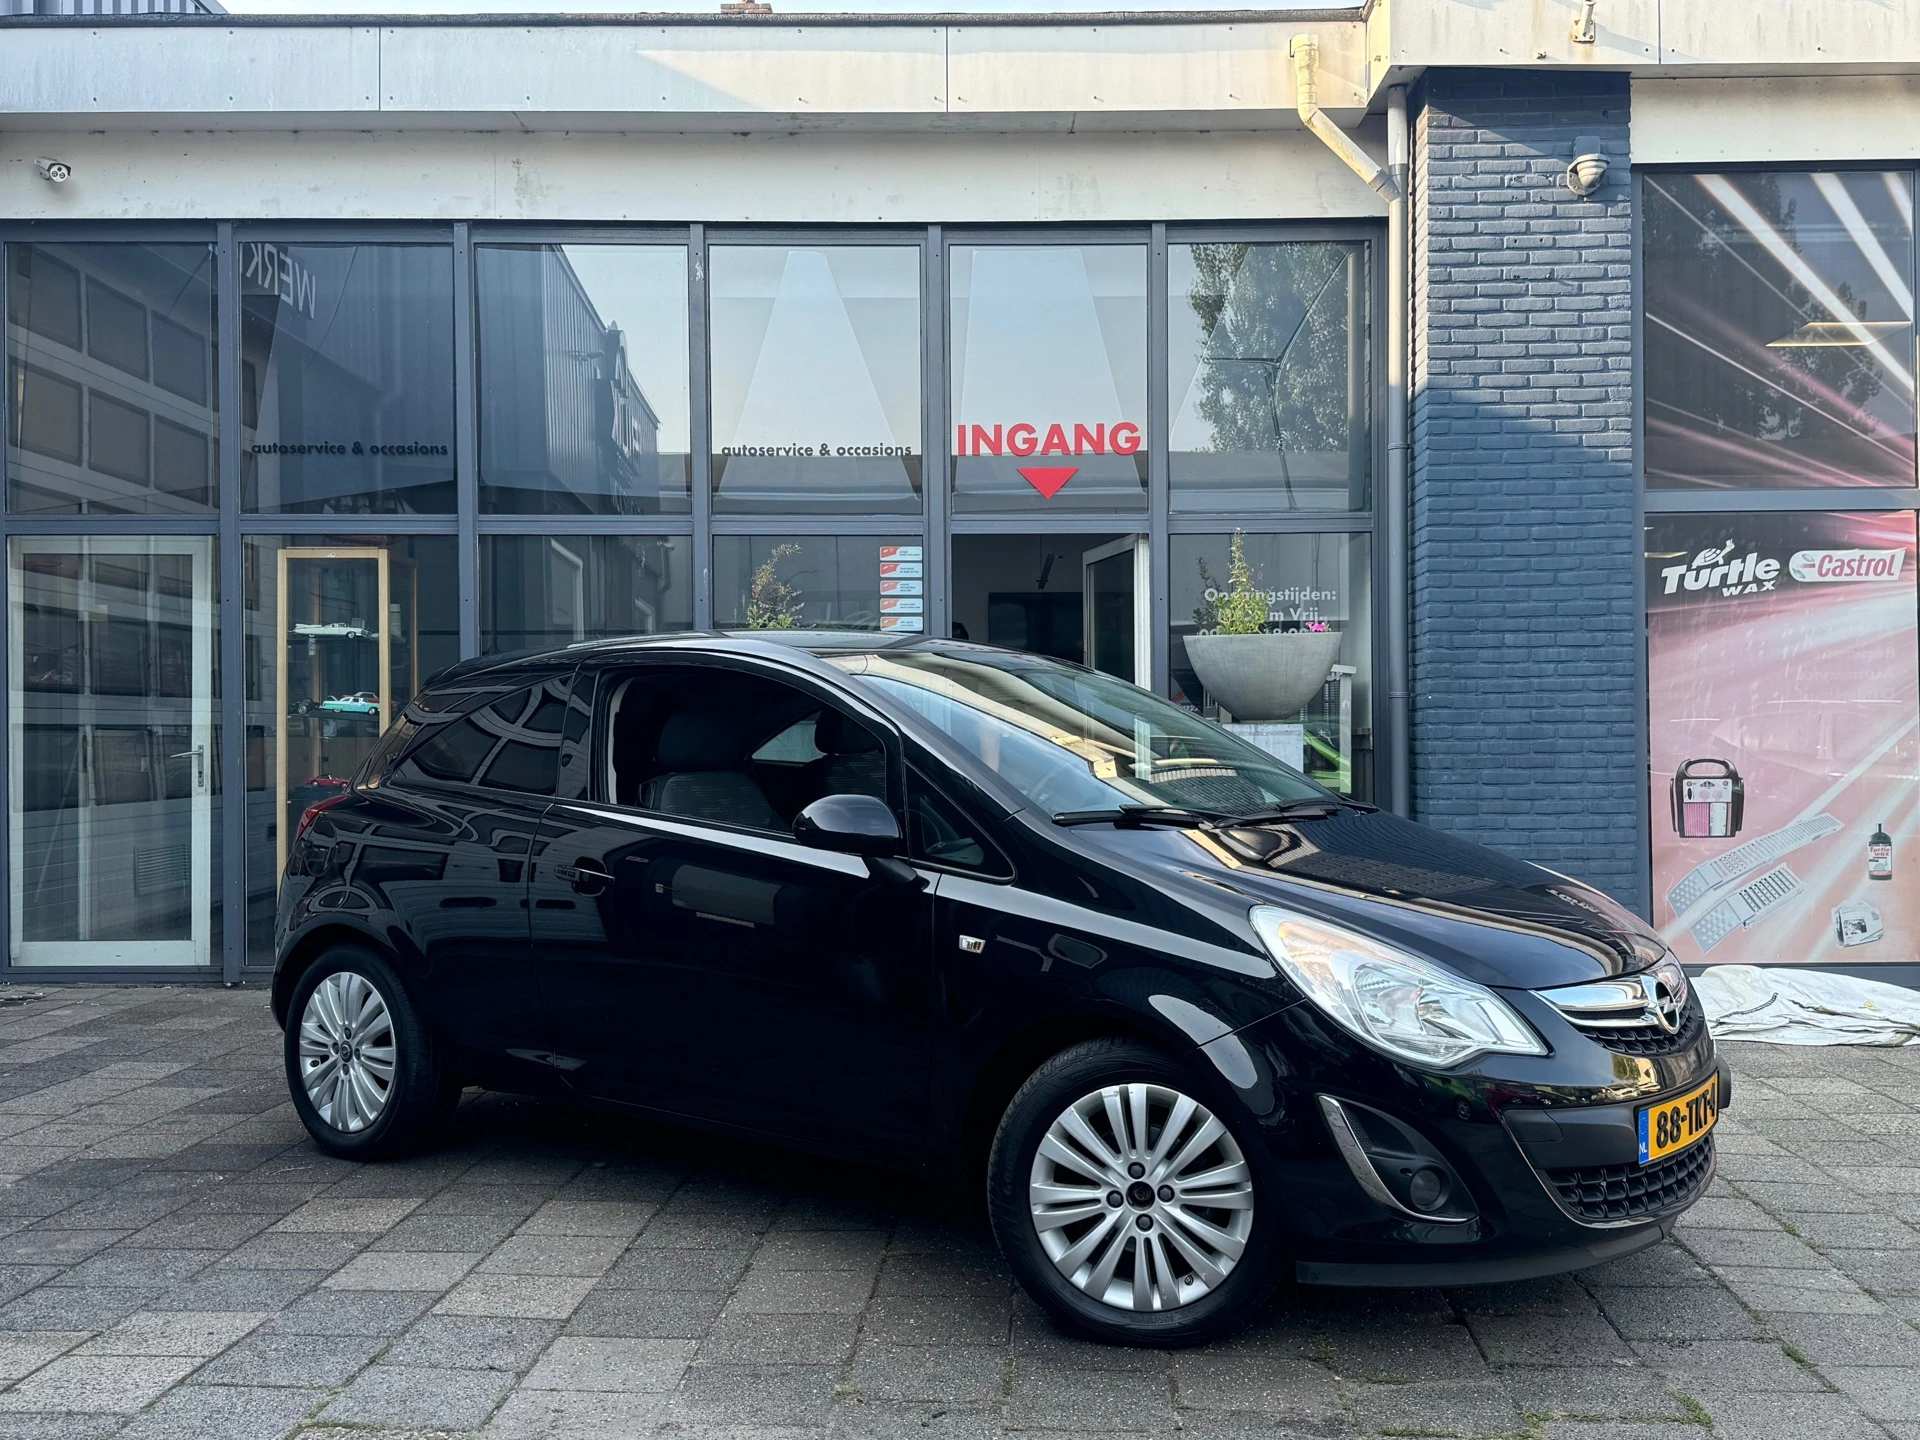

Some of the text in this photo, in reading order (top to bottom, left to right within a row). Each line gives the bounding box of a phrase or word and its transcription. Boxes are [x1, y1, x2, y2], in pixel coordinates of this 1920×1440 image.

[251, 441, 449, 456] autoservice & occasions
[957, 422, 1141, 457] INGANG
[721, 443, 912, 457] autoservice & occasions
[1661, 551, 1781, 595] Turtle
[1817, 553, 1896, 579] Castrol
[1722, 580, 1777, 598] WAX
[1639, 1142, 1648, 1155] NL
